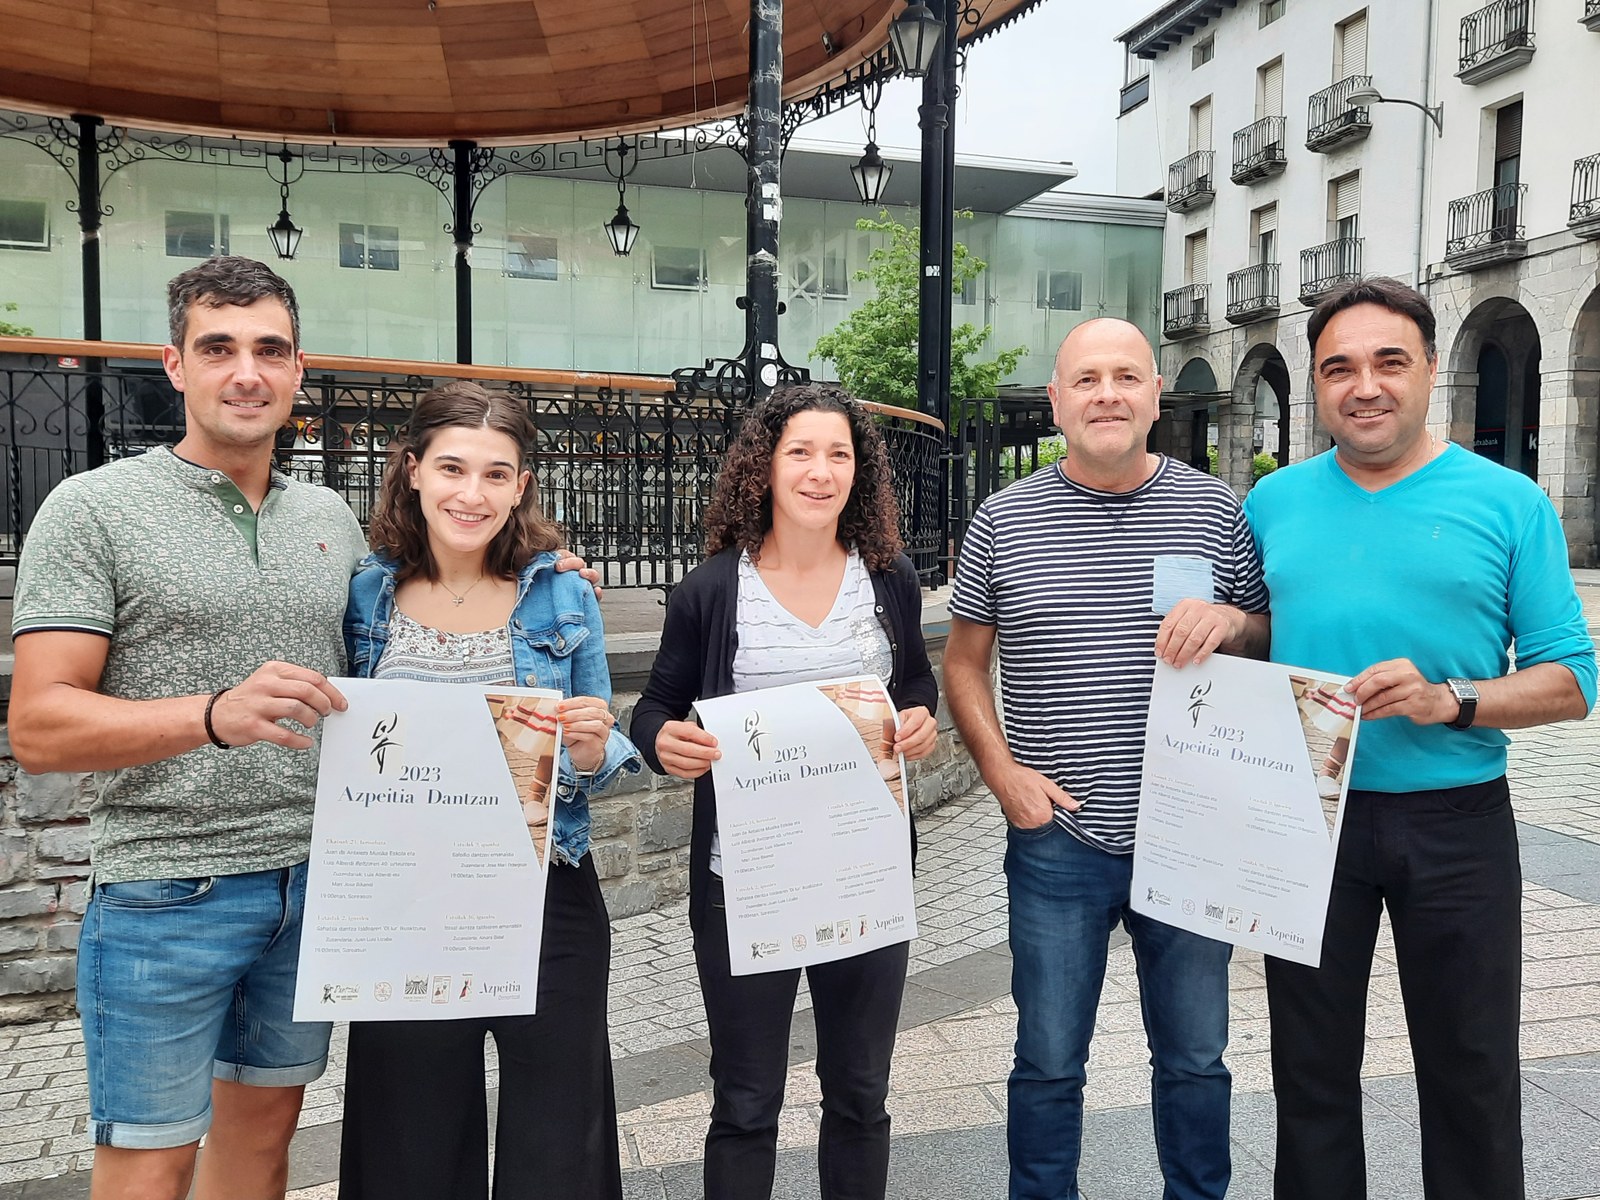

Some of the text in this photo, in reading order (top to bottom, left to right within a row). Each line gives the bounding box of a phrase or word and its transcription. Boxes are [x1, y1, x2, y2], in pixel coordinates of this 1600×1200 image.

[1208, 724, 1245, 743] 2023
[773, 744, 807, 764] 2023
[1159, 733, 1295, 773] Azpeitia Dantzan
[398, 765, 441, 782] 2023
[731, 760, 857, 791] Azpeitia Dantzan
[338, 785, 499, 808] Azpeitia Dantzan
[873, 912, 905, 931] Azpeitia
[1266, 925, 1306, 945] Azpeitia
[479, 981, 521, 997] Azpeitia
